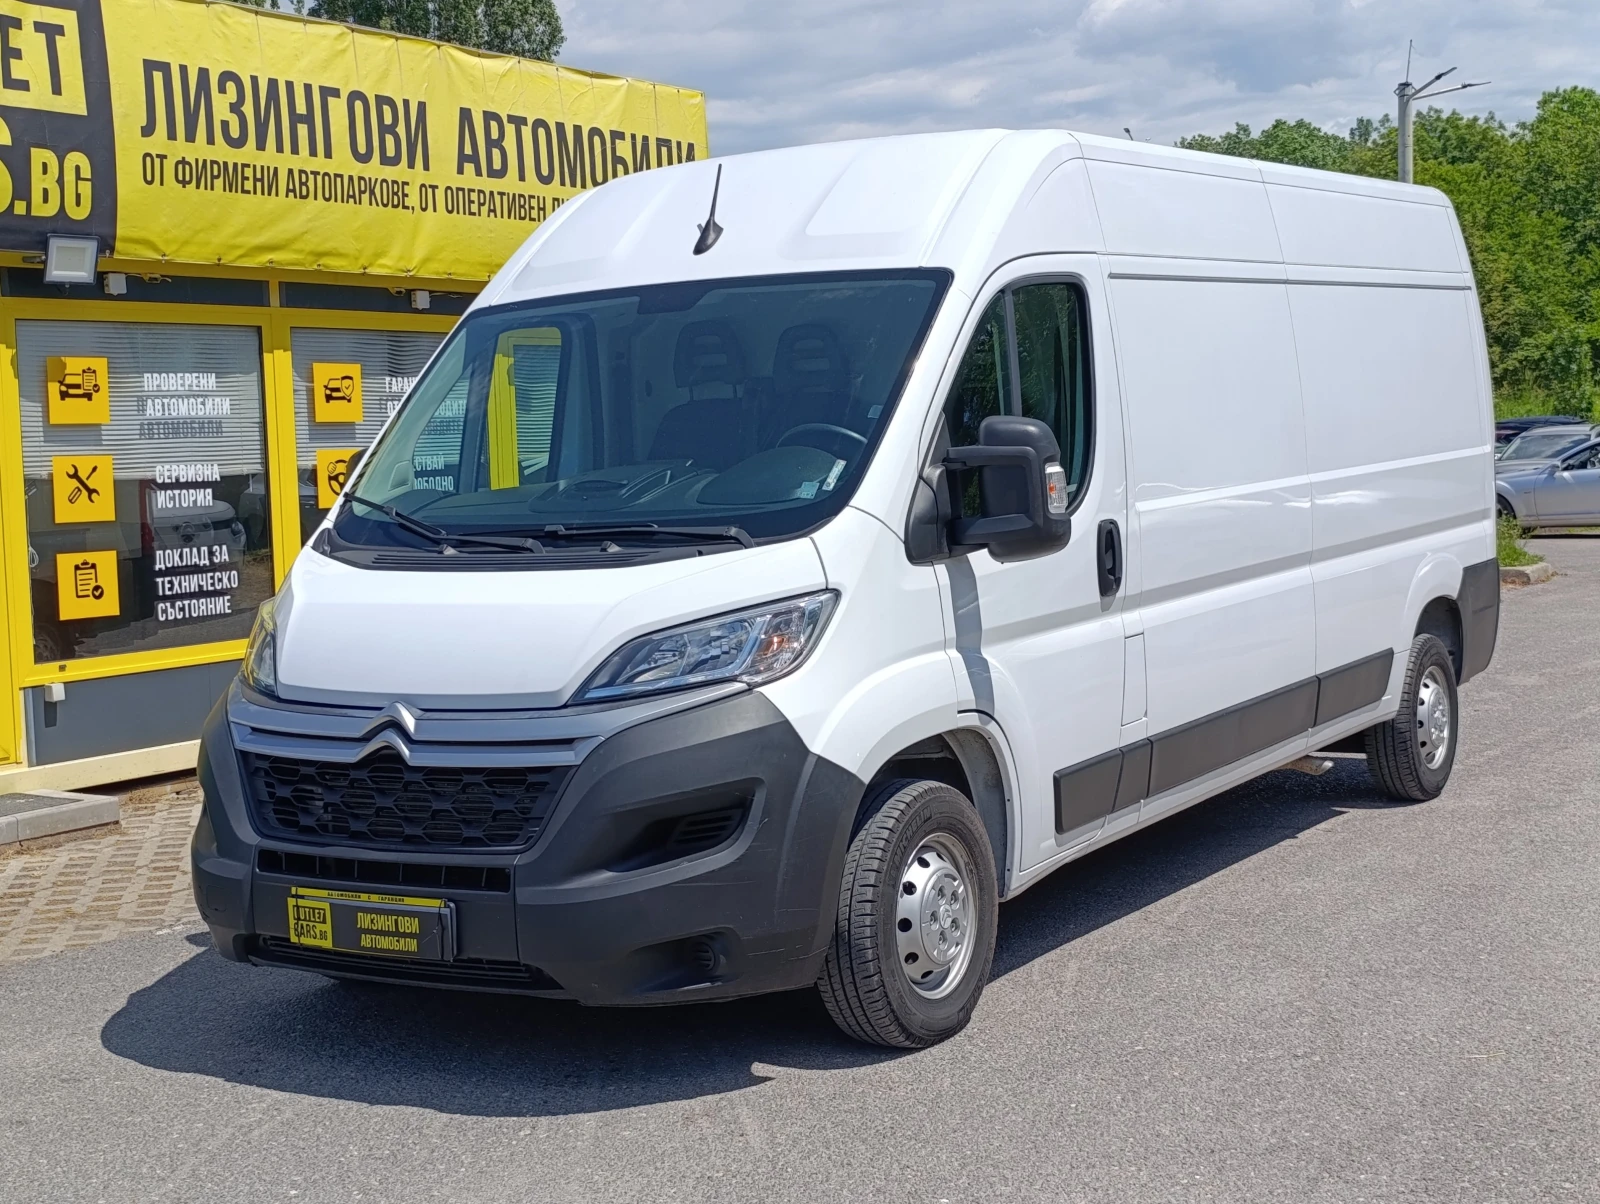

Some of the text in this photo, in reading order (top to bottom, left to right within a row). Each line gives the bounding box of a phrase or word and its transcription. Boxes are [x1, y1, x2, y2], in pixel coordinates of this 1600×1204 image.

[140, 58, 430, 172] ЛИЗИНГОВИ
[142, 152, 168, 186] ОТ
[174, 155, 280, 198] ФИРМЕНИ
[285, 167, 416, 215] АВТОПАРКОВЕ,
[418, 182, 439, 214] ОТ
[444, 185, 547, 223] ОПЕРАТИВЕН
[143, 372, 217, 391] ПРОВЕРЕНИ
[146, 396, 231, 417] АВТОМОБИЛИ
[155, 464, 220, 484] СЕРВИЗНА
[156, 488, 214, 509] ИСТОРИЯ
[154, 545, 229, 571] ДОКЛАД ЗА
[155, 570, 239, 596] ТЕХНИЧЕСКО
[158, 596, 232, 621] СЪСТОЯНИЕ
[357, 911, 420, 934] ЛИЗИНГОВИ
[360, 933, 418, 952] АВТОМОБИЛИ
